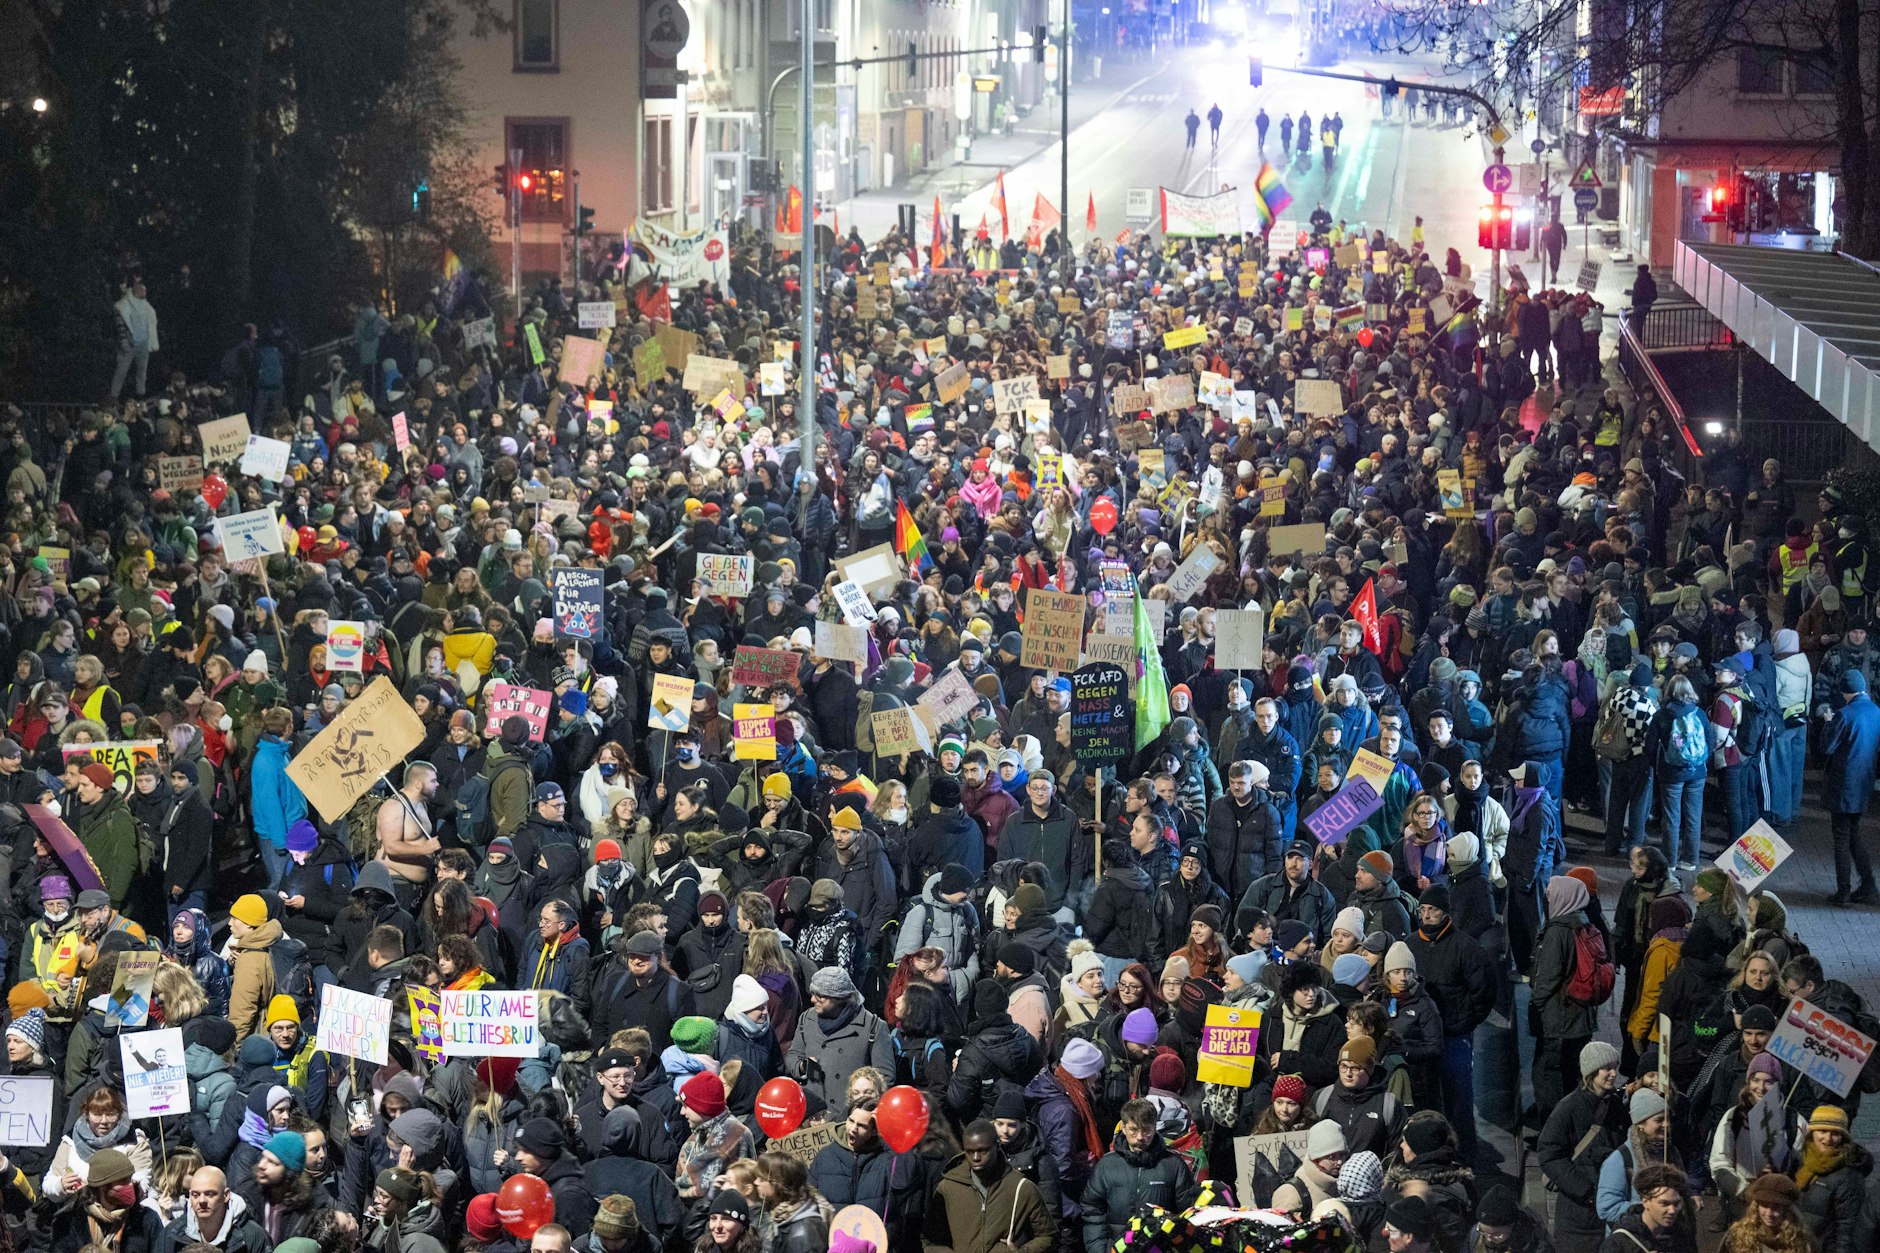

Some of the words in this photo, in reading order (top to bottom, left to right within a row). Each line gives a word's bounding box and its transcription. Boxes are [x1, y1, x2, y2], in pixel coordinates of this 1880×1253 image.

[704, 243, 723, 255] STOP
[1581, 269, 1598, 280] GEGEN
[1577, 277, 1597, 288] RECHTS
[1002, 381, 1032, 397] FCK
[162, 462, 181, 471] WER
[164, 480, 174, 488] IST
[702, 570, 747, 581] GEGEN
[708, 581, 749, 595] ECHTS!
[1033, 595, 1050, 606] DIE
[1028, 622, 1080, 641] MENSCHEN
[1026, 638, 1039, 650] IST
[1043, 640, 1065, 652] KEIN
[736, 651, 786, 667] NAZIS
[1073, 672, 1096, 687] FCK
[1099, 670, 1123, 685] AFD
[665, 682, 682, 690] WIEDER
[1076, 686, 1118, 699] GEGEN
[510, 688, 532, 702] AFD
[943, 688, 960, 706] KEINE
[524, 701, 549, 719] SIT
[1078, 700, 1110, 712] HASS
[1113, 704, 1125, 718] &
[738, 718, 770, 730] STOPPT
[1073, 711, 1111, 725] HETZE
[739, 728, 753, 738] DIE
[754, 727, 771, 738] AFD
[876, 728, 887, 736] DIE
[891, 725, 909, 735] AFD
[893, 732, 909, 742] WEG
[1072, 726, 1097, 737] KEINE
[1101, 724, 1129, 736] MACHT
[1088, 737, 1110, 747] DEN
[1076, 747, 1125, 759] RADIKALEN
[1364, 760, 1383, 772] WIEDER
[128, 961, 148, 969] WIEDER
[426, 1023, 439, 1034] AFD
[1209, 1028, 1252, 1042] STOPPT
[1208, 1040, 1227, 1054] DIE
[1228, 1041, 1251, 1054] AFD
[1769, 1035, 1806, 1068] ALICE
[1803, 1036, 1840, 1062] gegen
[126, 1074, 145, 1088] NIE
[146, 1066, 186, 1085] WIEDER!
[1247, 1137, 1273, 1157] Say
